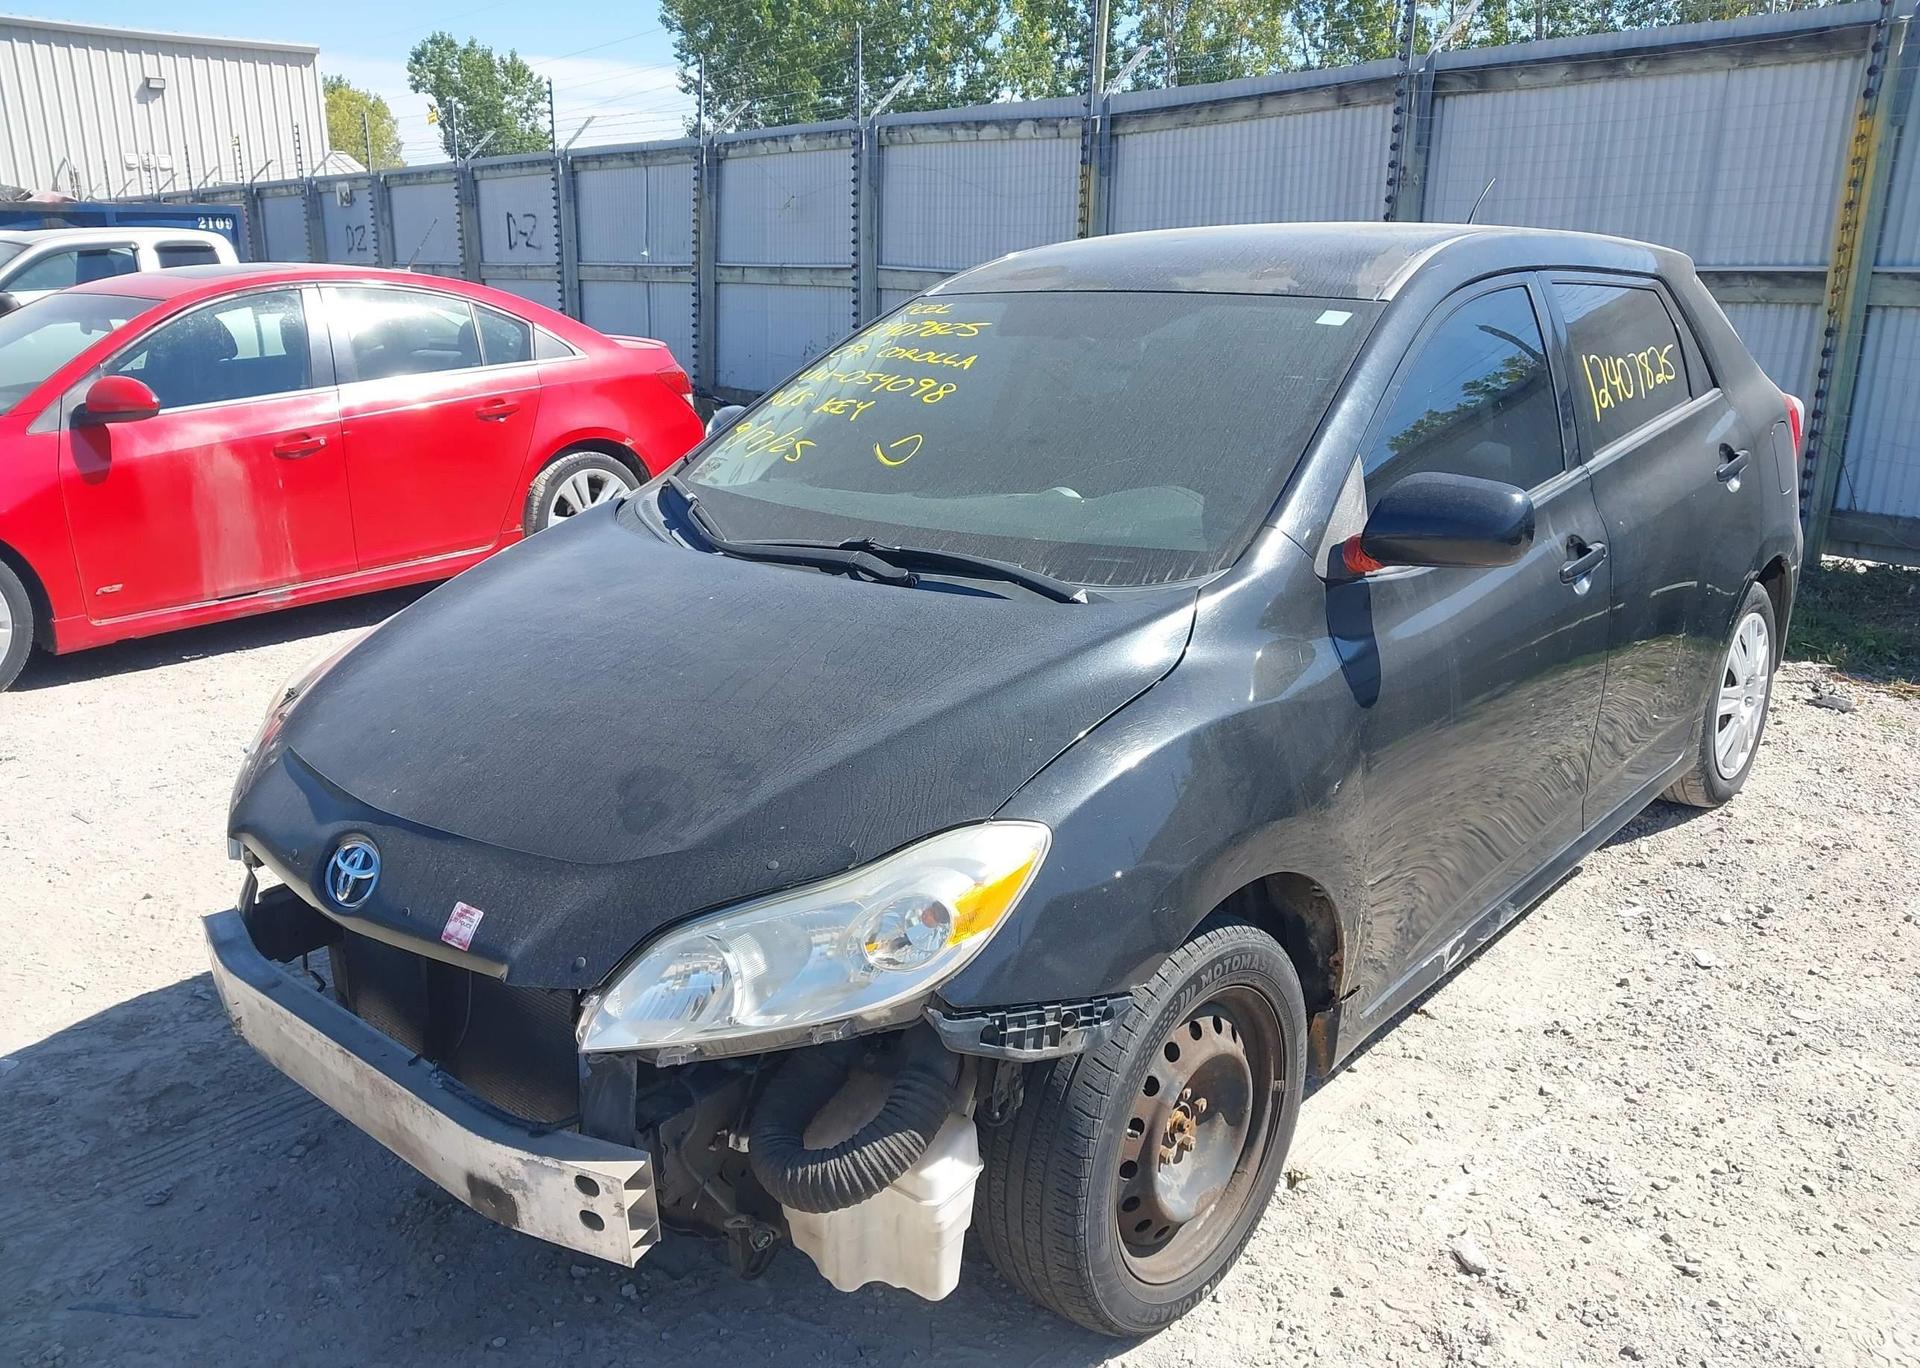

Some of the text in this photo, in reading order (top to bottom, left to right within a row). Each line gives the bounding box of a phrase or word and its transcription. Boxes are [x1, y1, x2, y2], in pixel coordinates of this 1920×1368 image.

[198, 216, 234, 230] 2109
[876, 346, 978, 370] COROLLA
[1582, 344, 1676, 423] 12407825
[812, 397, 876, 422] KEY
